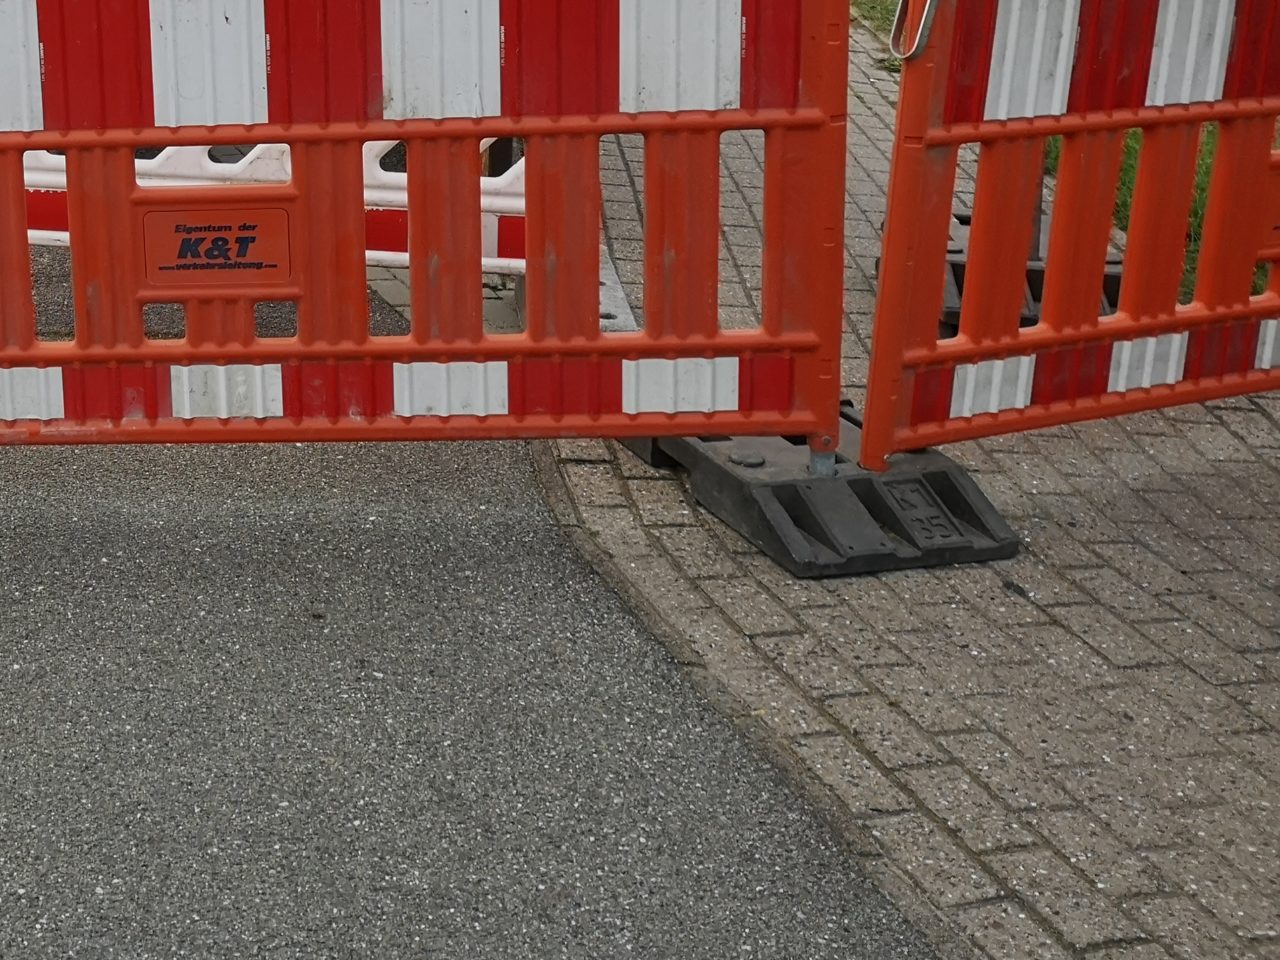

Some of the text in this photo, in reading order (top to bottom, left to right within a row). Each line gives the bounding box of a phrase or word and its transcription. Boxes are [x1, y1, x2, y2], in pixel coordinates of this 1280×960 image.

[174, 223, 258, 235] Eigentum der
[177, 236, 257, 261] K&T
